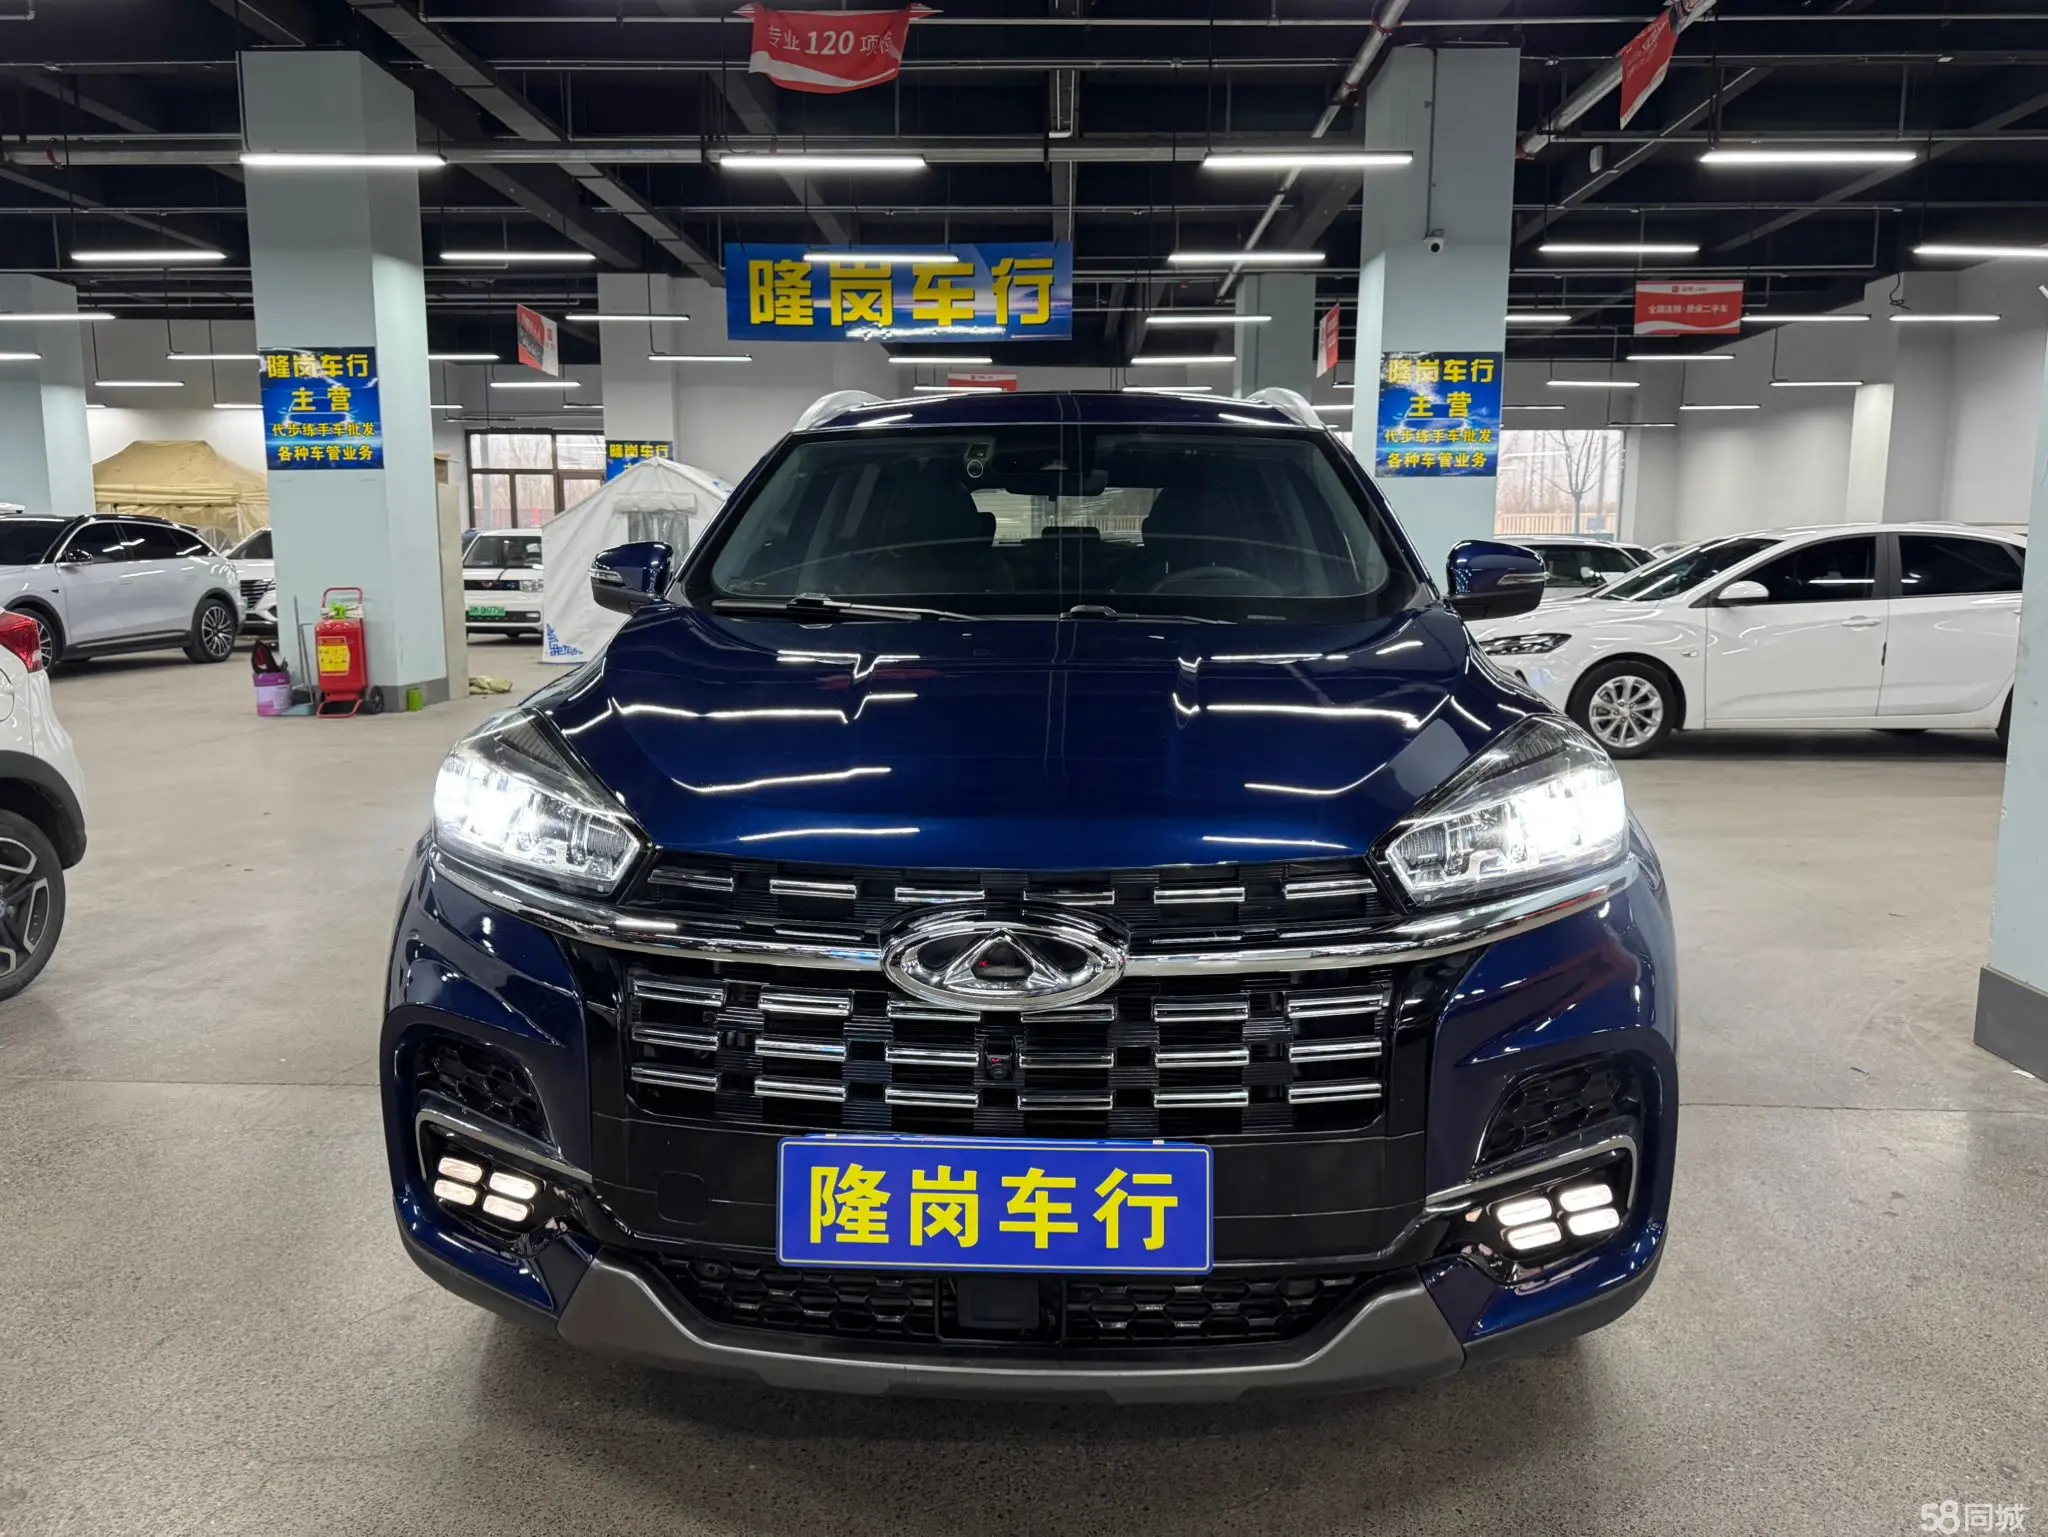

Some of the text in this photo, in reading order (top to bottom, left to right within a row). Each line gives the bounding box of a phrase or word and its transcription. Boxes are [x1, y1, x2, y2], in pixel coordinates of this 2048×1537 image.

[768, 26, 800, 51] 专业
[805, 31, 855, 55] 120
[749, 257, 1055, 326] 隆岗车行
[266, 353, 369, 378] 隆岗车行
[1388, 358, 1495, 384] 隆岗车行
[291, 385, 352, 412] 主营
[1408, 391, 1472, 418] 主营
[272, 422, 376, 437] 代步练手车批发
[278, 445, 373, 461] 各种车管业务
[1387, 452, 1487, 468] 各种车管业务
[809, 1162, 1179, 1251] 隆岗车行
